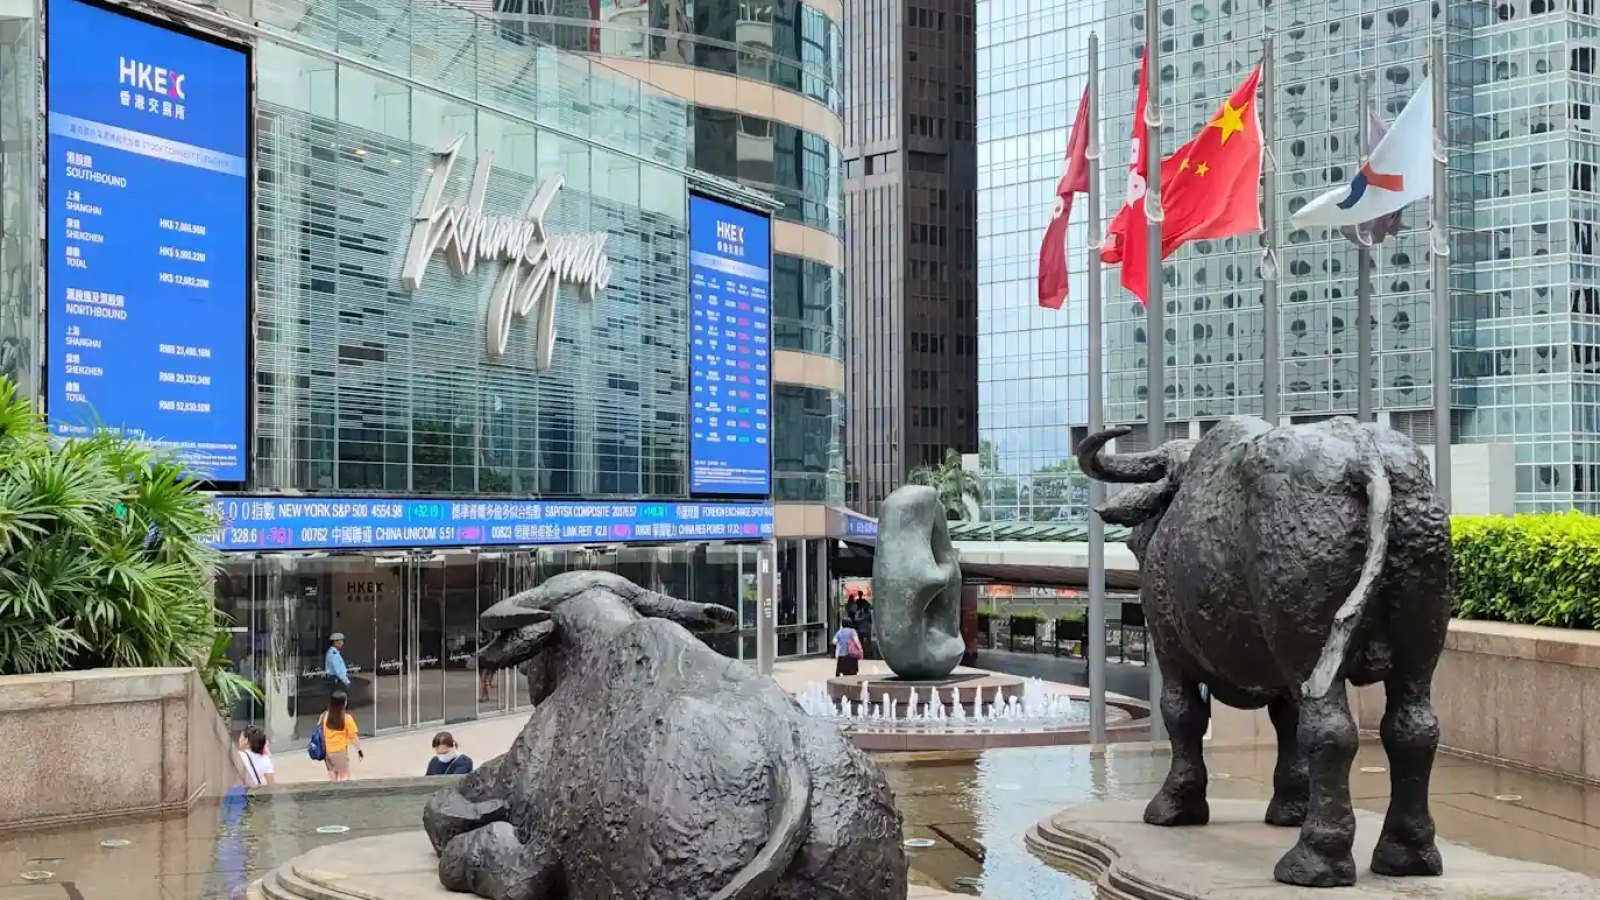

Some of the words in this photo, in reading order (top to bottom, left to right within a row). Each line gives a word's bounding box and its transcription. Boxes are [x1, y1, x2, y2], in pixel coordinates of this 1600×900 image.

[119, 56, 185, 99] HKEX
[119, 90, 186, 121] 香港交易所
[66, 167, 127, 188] SOUTHBOUND
[66, 201, 102, 216] SHANGHAI
[66, 229, 104, 243] SHENZHEN
[716, 219, 744, 243] HKEX
[159, 246, 174, 258] HK$
[66, 258, 87, 269] TOTAL
[159, 272, 174, 283] HK$
[66, 303, 127, 320] NORTHBOUND
[65, 336, 102, 348] SHANGHAI
[159, 343, 175, 354] RMB
[65, 365, 103, 376] SHENZHEN
[159, 371, 175, 382] RMB
[65, 393, 86, 402] TOTAL
[159, 400, 175, 410] RMB
[278, 503, 302, 517] NEW
[304, 503, 331, 518] YORK
[332, 503, 350, 518] S&P
[352, 504, 368, 518] 500
[371, 504, 402, 518] 4554.98
[573, 505, 610, 518] COMPOSITE
[301, 527, 328, 542] 00762
[375, 527, 402, 542] CHINA
[403, 526, 436, 541] UNICOM
[439, 526, 455, 540] 5.51
[563, 525, 578, 537] LINK
[578, 525, 593, 537] REIT
[707, 523, 725, 535] POWER
[231, 528, 257, 543] 328.6
[347, 581, 384, 593] HKEX
